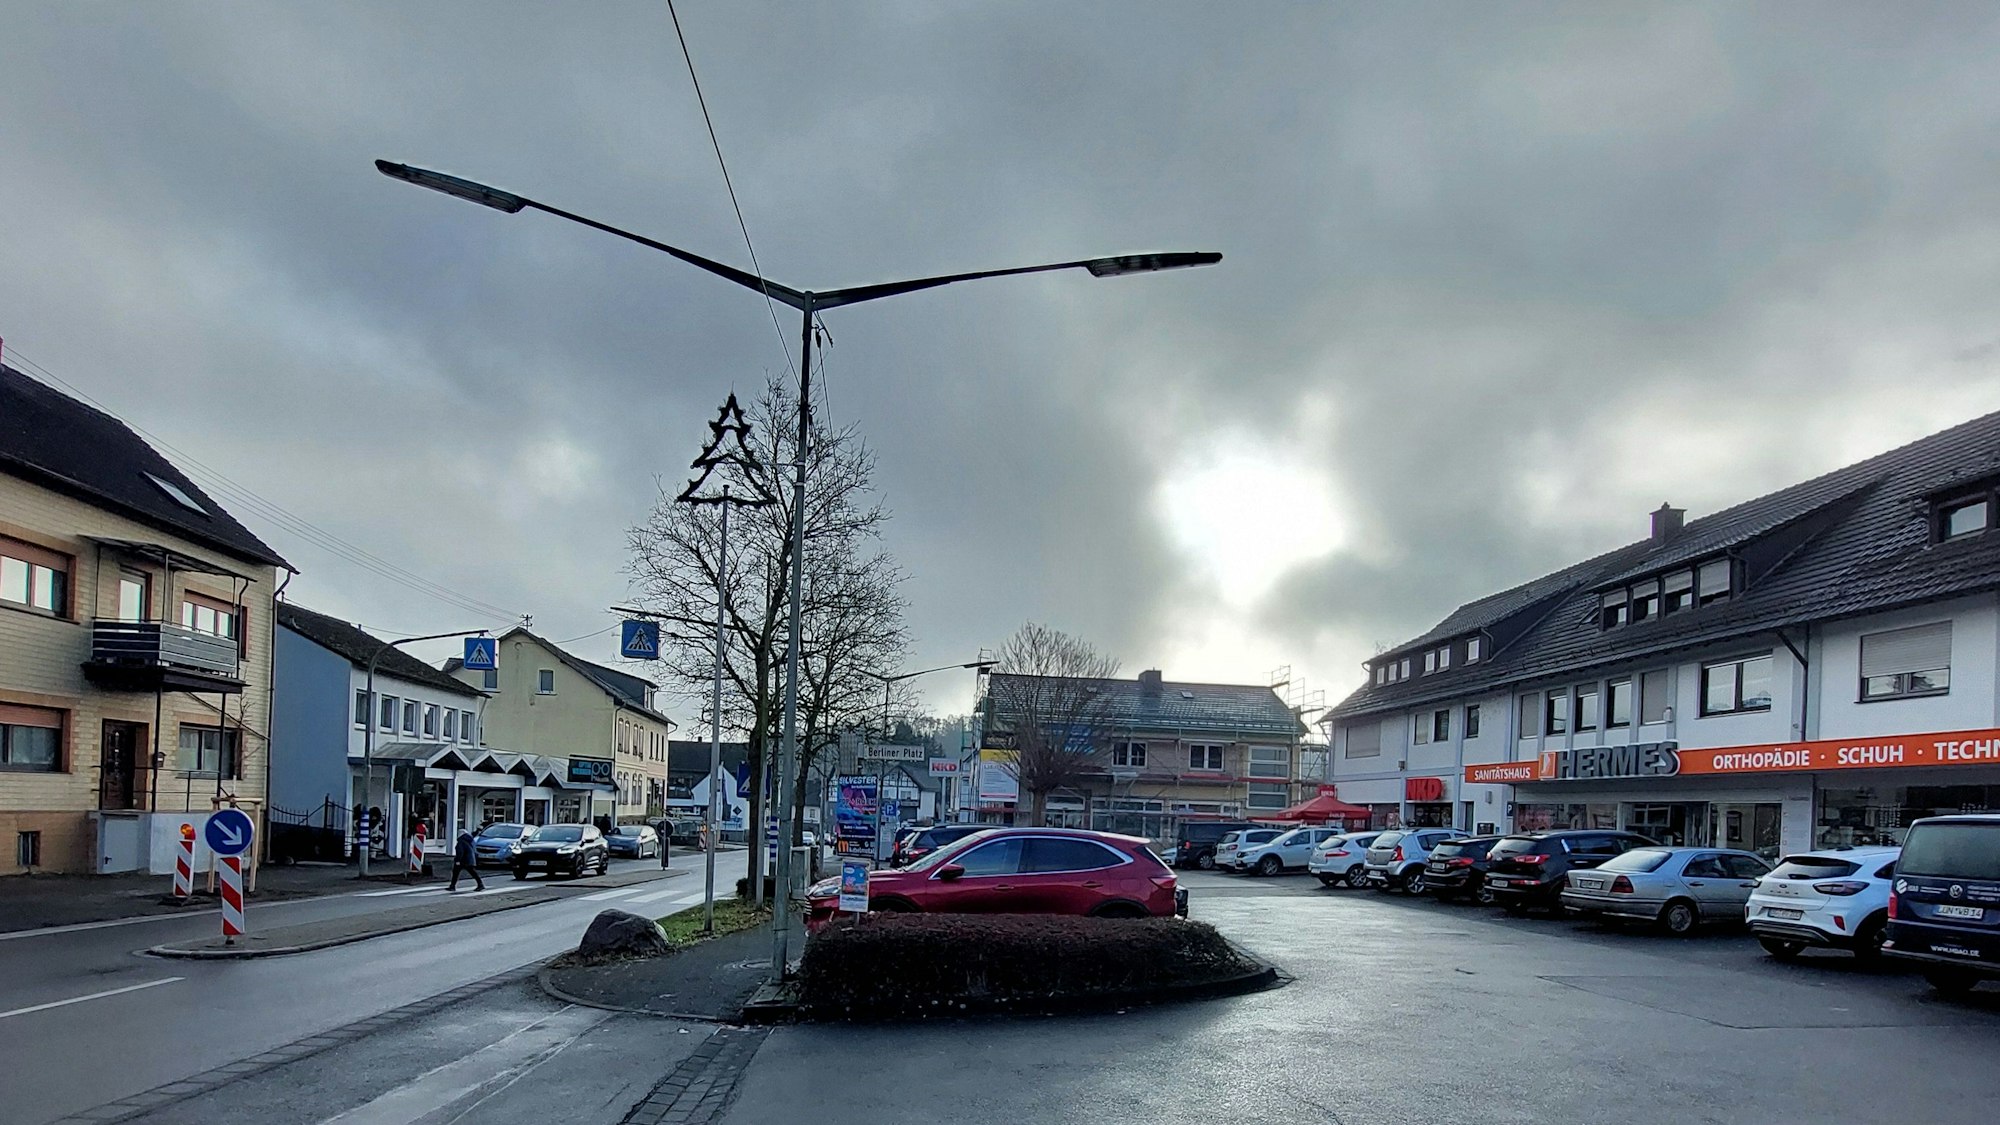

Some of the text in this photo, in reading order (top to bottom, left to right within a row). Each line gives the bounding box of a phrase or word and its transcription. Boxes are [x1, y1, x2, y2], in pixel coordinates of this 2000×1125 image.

[868, 747, 923, 758] Berliner Platz
[1713, 748, 1810, 770] ORTHOPÄDIE
[1837, 745, 1904, 765] SCHUH
[1557, 741, 1679, 778] HERMES
[932, 763, 957, 771] NKD
[1474, 766, 1531, 780] SANITÄTSHAUS
[839, 776, 877, 785] SILVESTER
[1406, 778, 1444, 801] NKD
[1507, 804, 1512, 814] P
